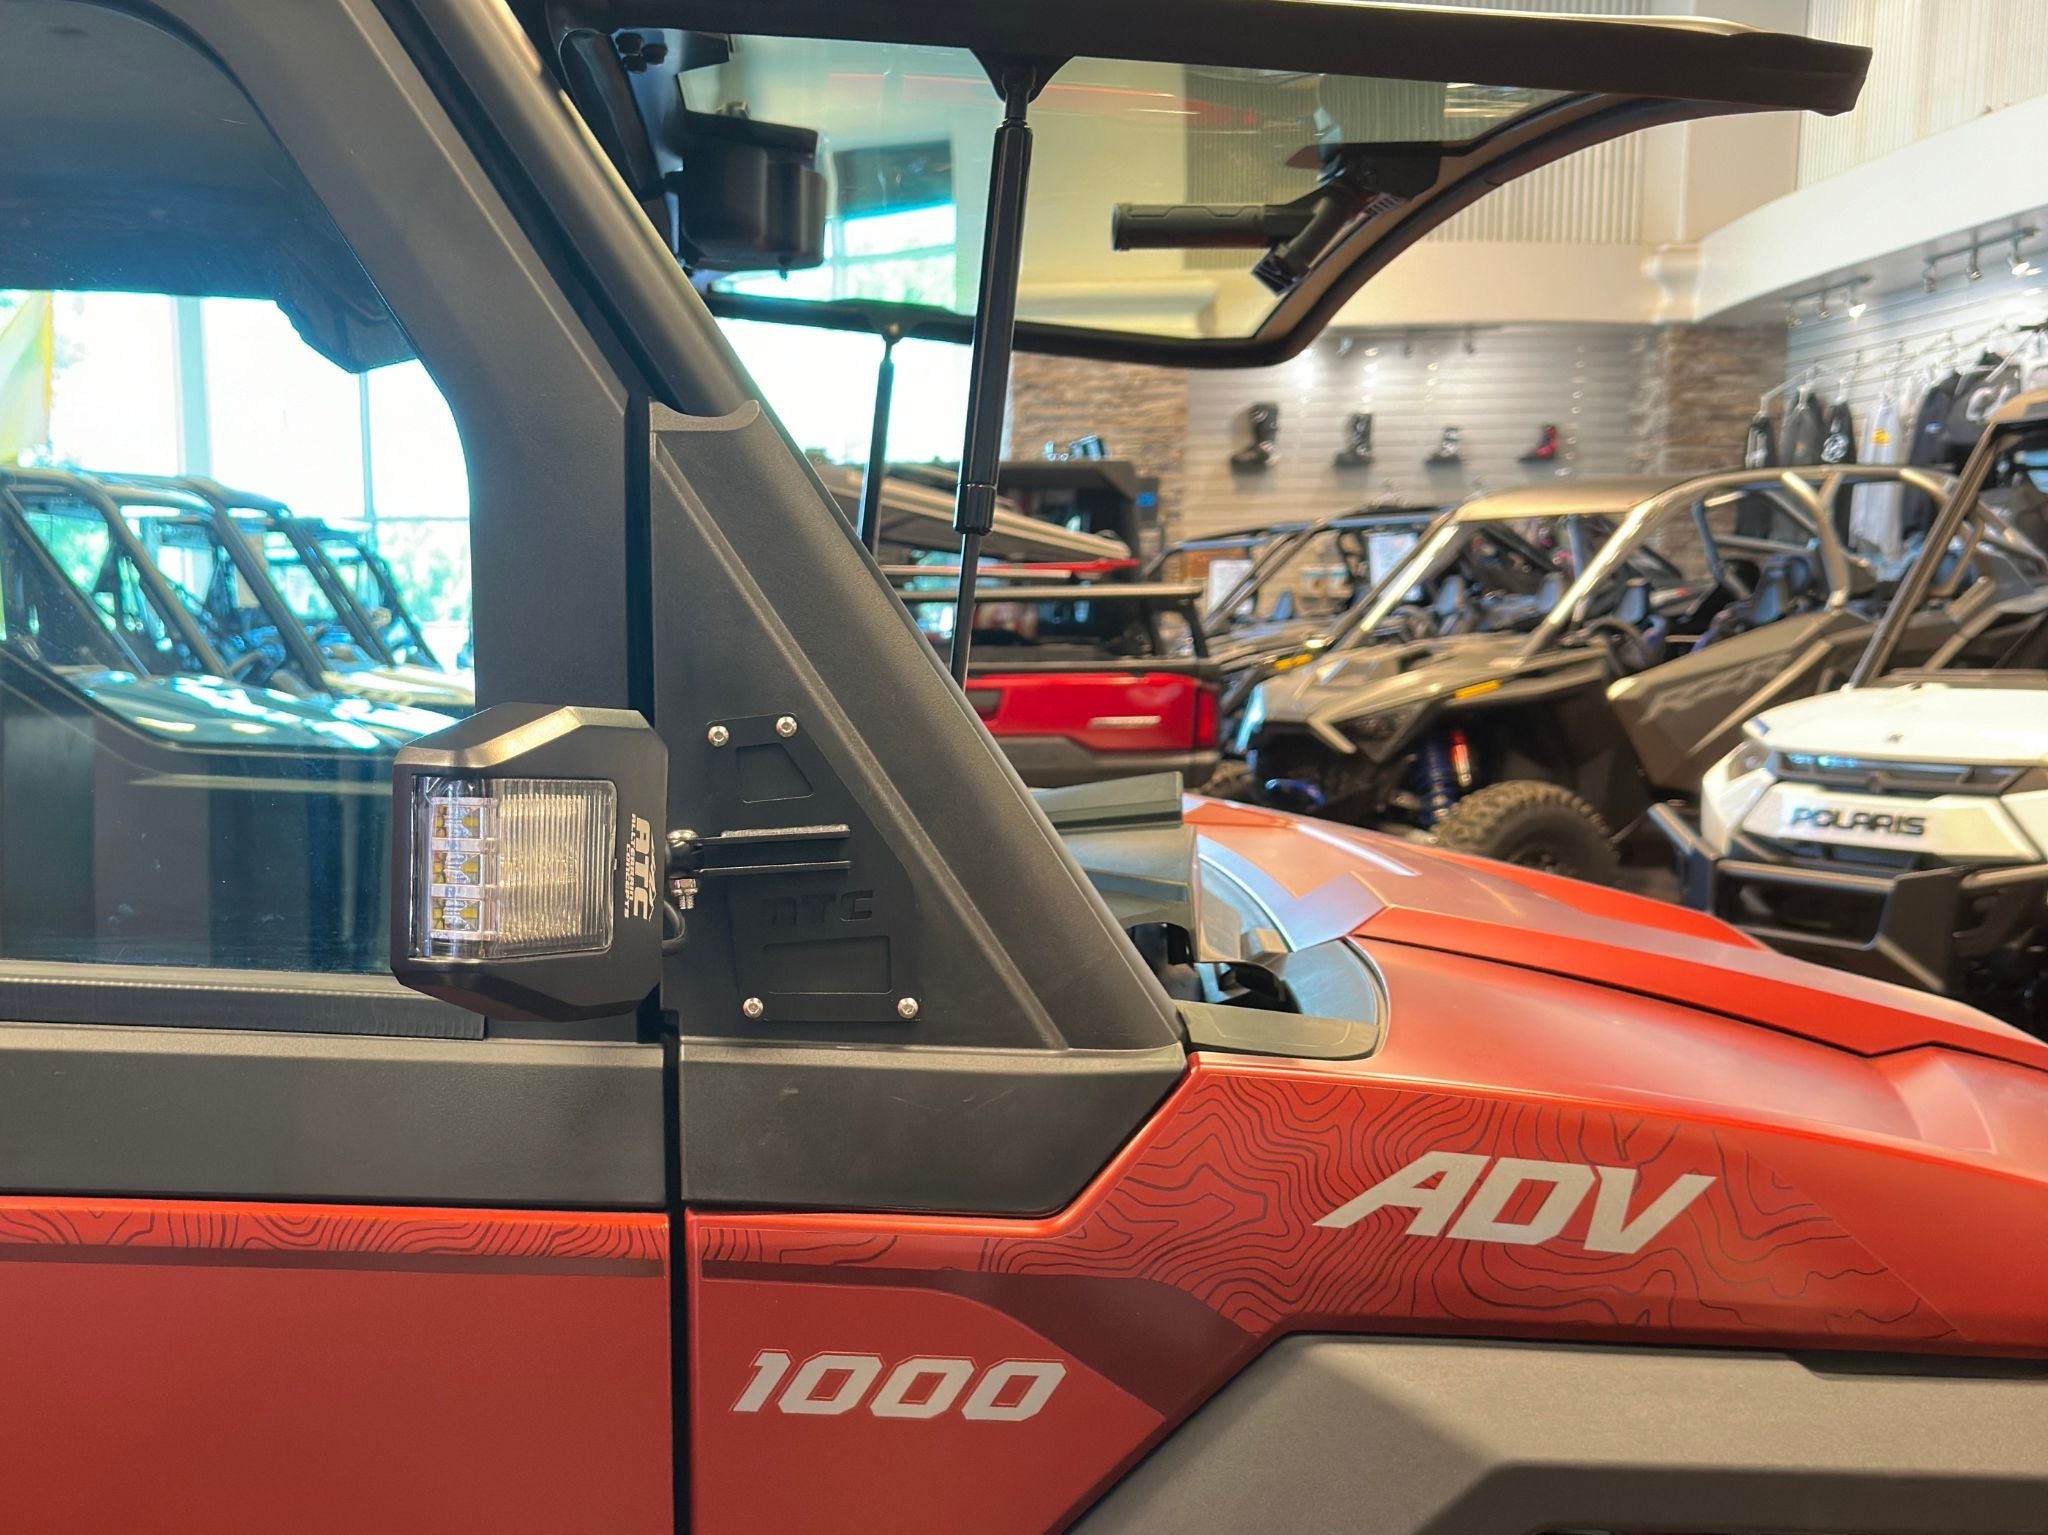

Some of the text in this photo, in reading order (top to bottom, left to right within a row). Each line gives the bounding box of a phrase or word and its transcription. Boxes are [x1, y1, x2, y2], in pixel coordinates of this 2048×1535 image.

[1790, 807, 1927, 836] POLARIS
[633, 816, 651, 920] ATC
[1311, 1150, 1718, 1254] ADV
[731, 1350, 1067, 1422] 1000
